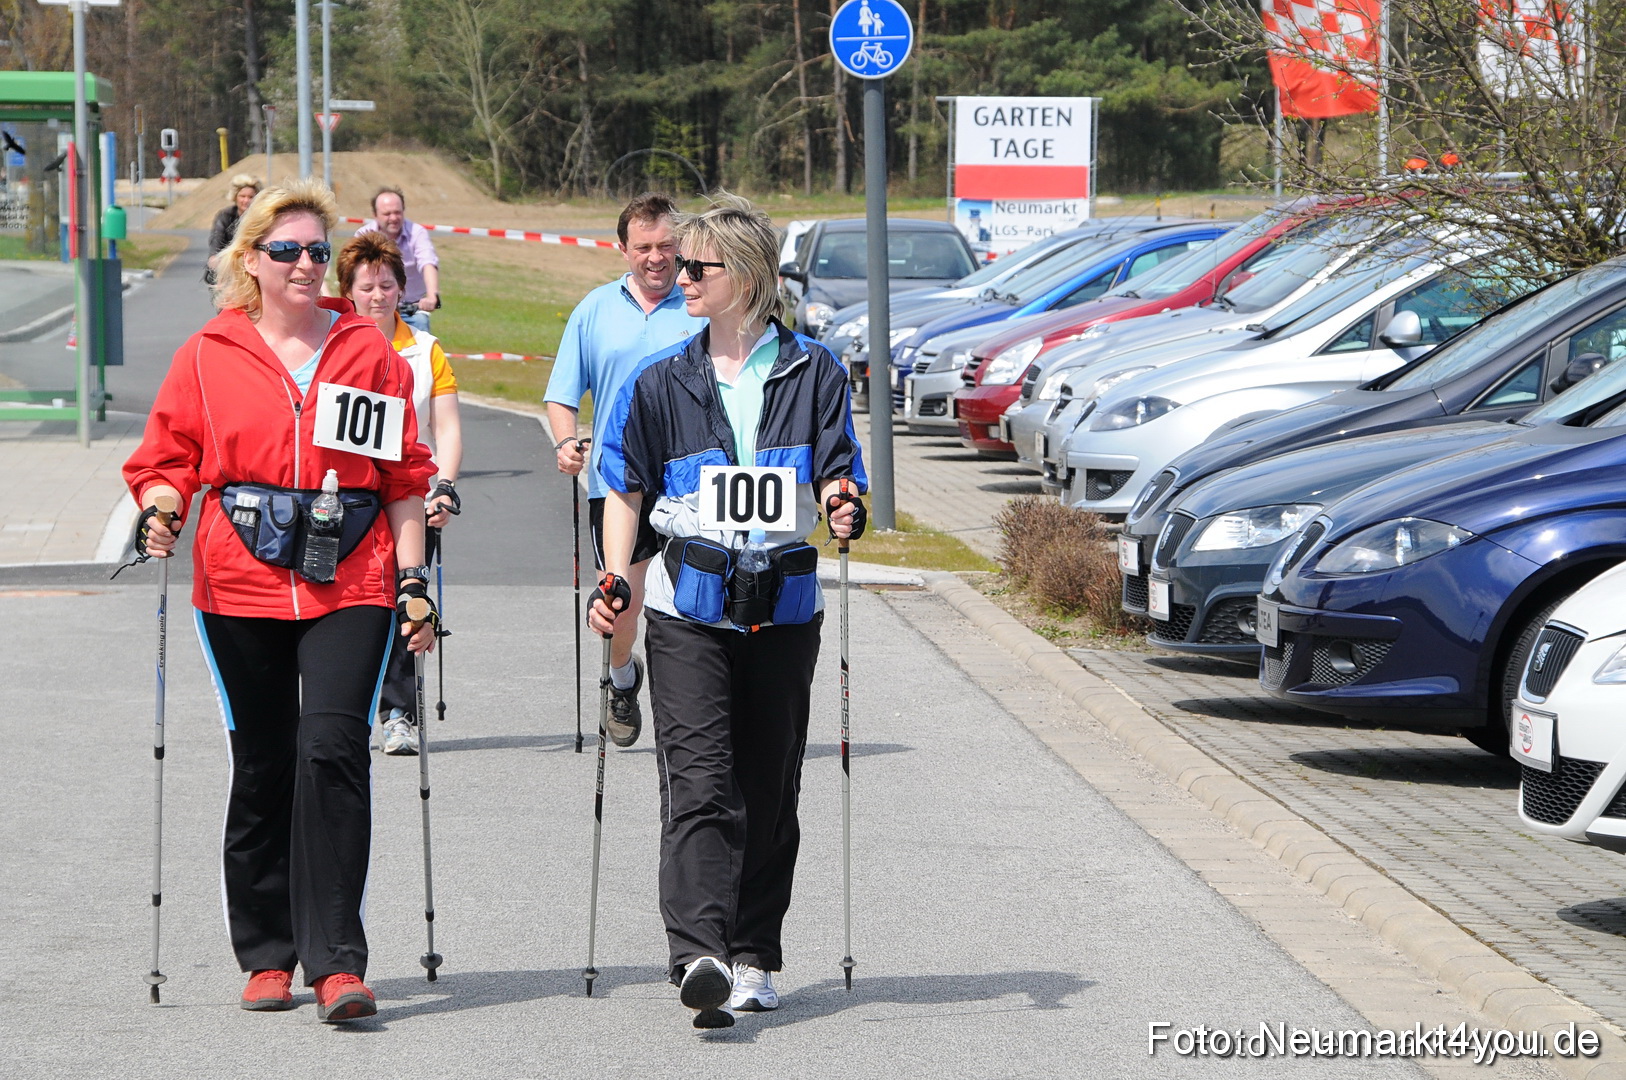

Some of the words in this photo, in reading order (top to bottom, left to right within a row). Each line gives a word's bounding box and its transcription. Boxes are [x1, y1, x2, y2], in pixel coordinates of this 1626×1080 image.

[974, 106, 1072, 127] GARTEN
[990, 138, 1054, 159] TAGE
[995, 201, 1078, 215] Neumarkt
[335, 392, 387, 450] 101
[712, 472, 783, 523] 100
[841, 672, 850, 741] FLASH
[596, 736, 606, 793] FLASH
